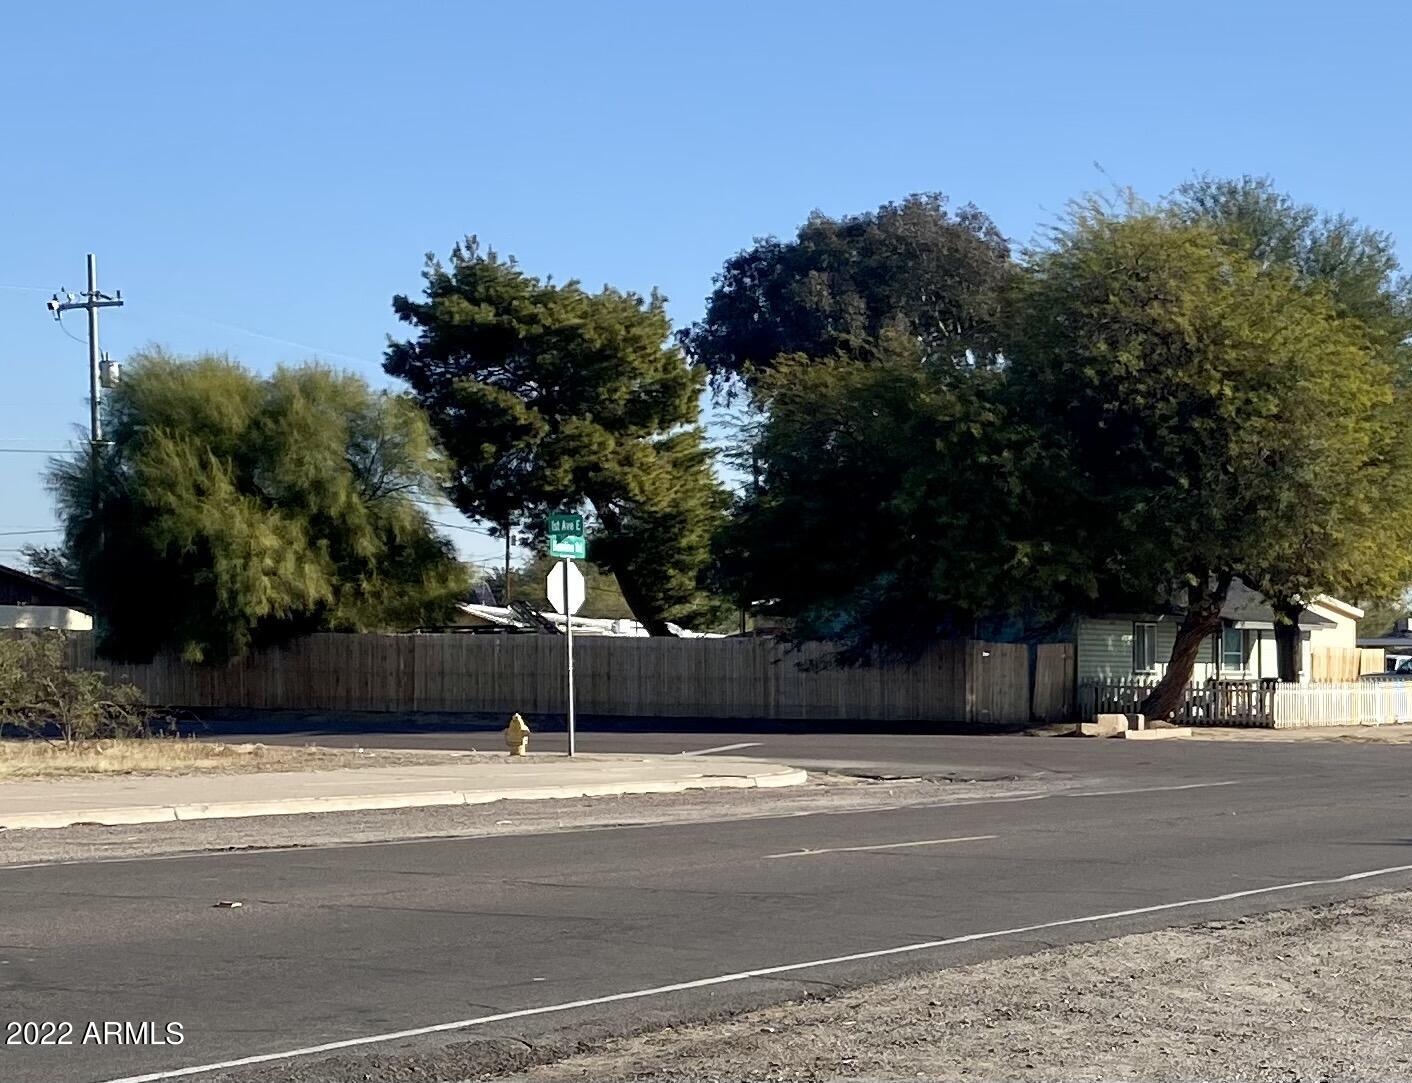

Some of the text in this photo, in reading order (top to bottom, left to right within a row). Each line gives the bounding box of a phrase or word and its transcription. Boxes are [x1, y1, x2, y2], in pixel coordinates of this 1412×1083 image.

[551, 519, 581, 531] 1st Ave E
